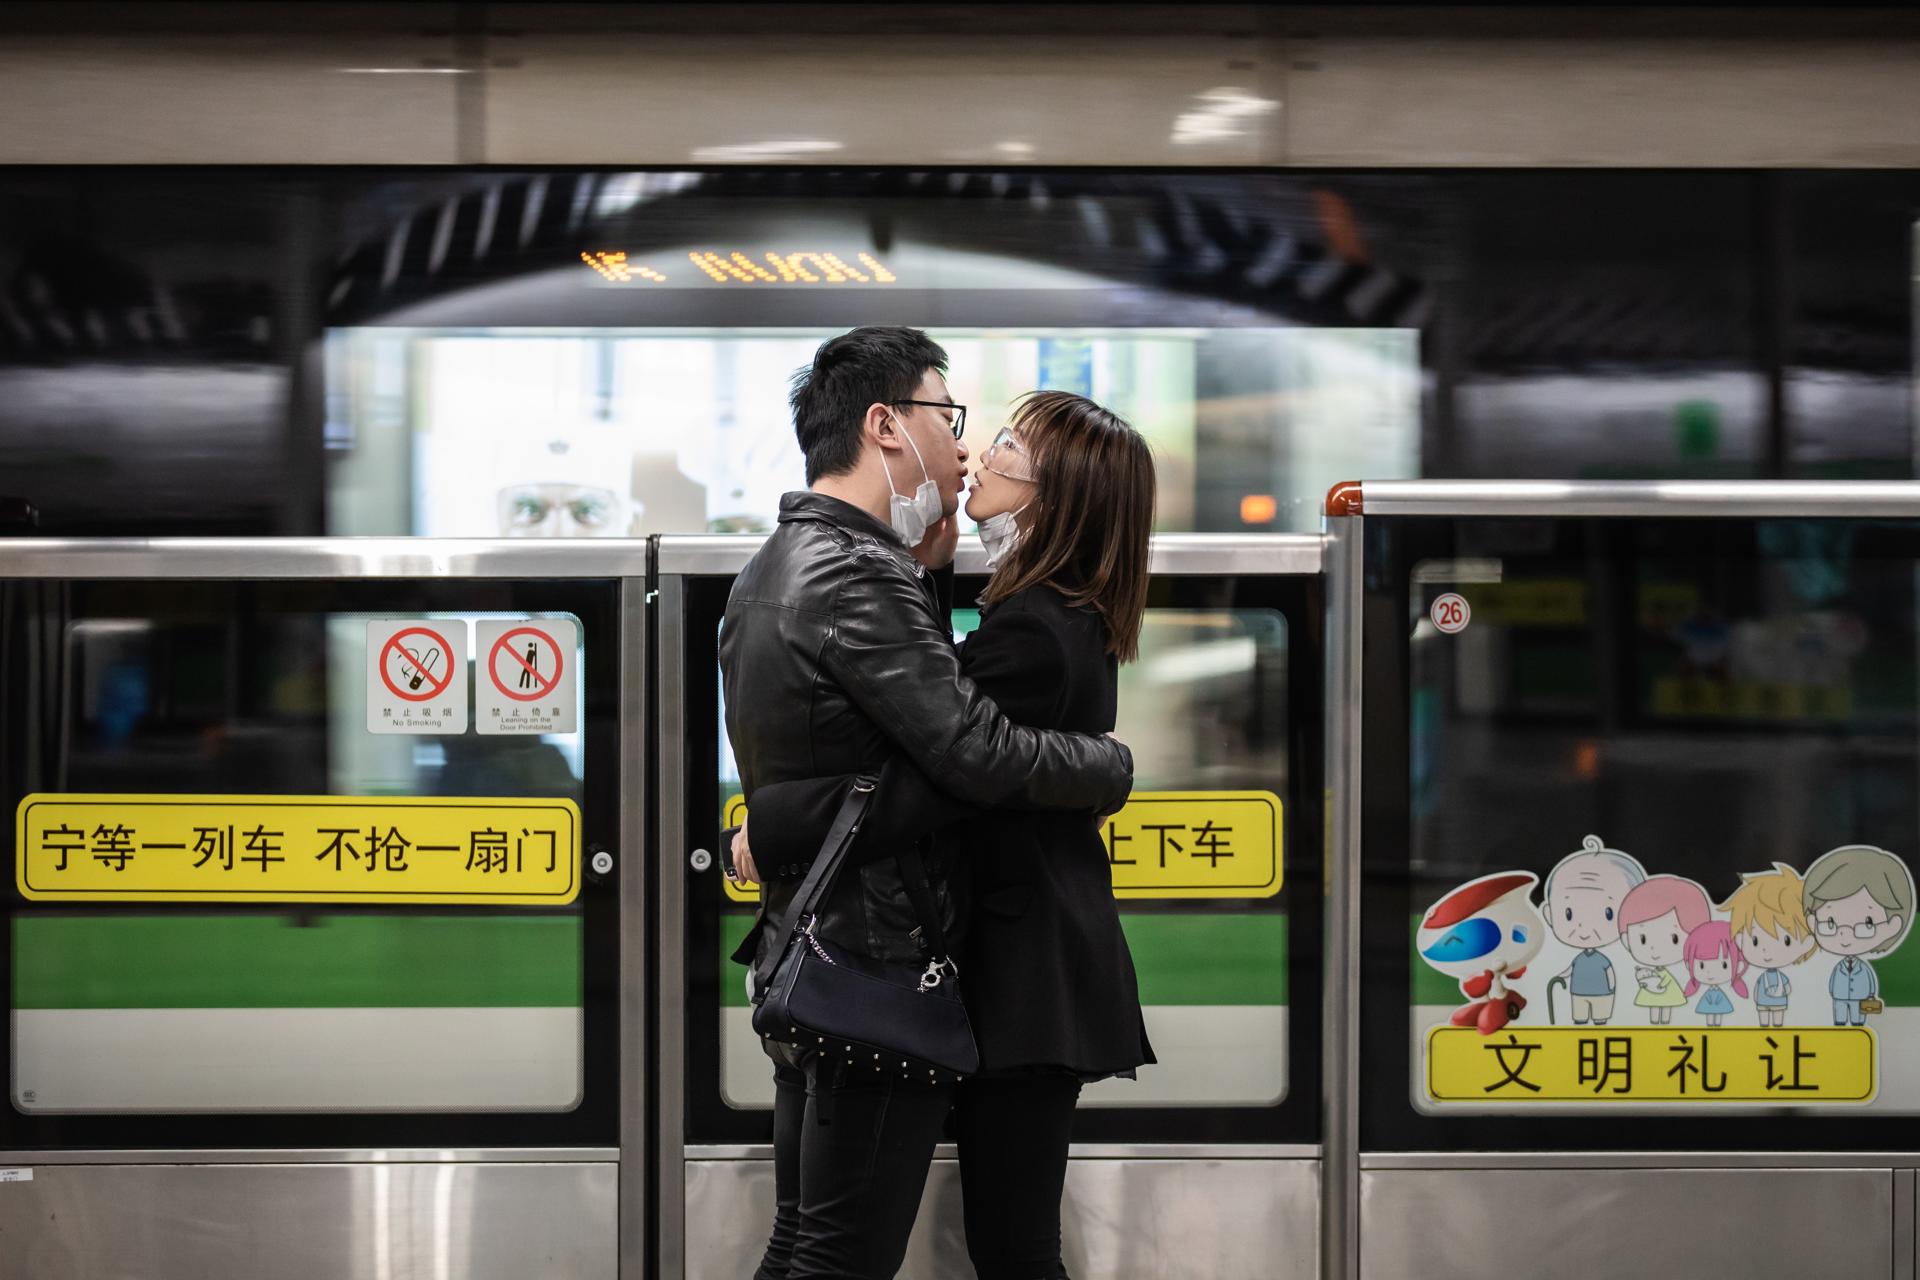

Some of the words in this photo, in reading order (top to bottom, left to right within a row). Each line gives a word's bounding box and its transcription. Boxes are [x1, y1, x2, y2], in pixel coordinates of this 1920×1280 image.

[1439, 601, 1463, 624] 26
[383, 707, 453, 718] 禁止吸烟
[392, 719, 404, 727] No
[407, 718, 442, 728] Smoking
[41, 823, 286, 875] 宁等一列车
[315, 826, 557, 875] 不抢一扇门
[1108, 820, 1235, 868] 上下车
[1483, 1034, 1820, 1094] 文明礼让
